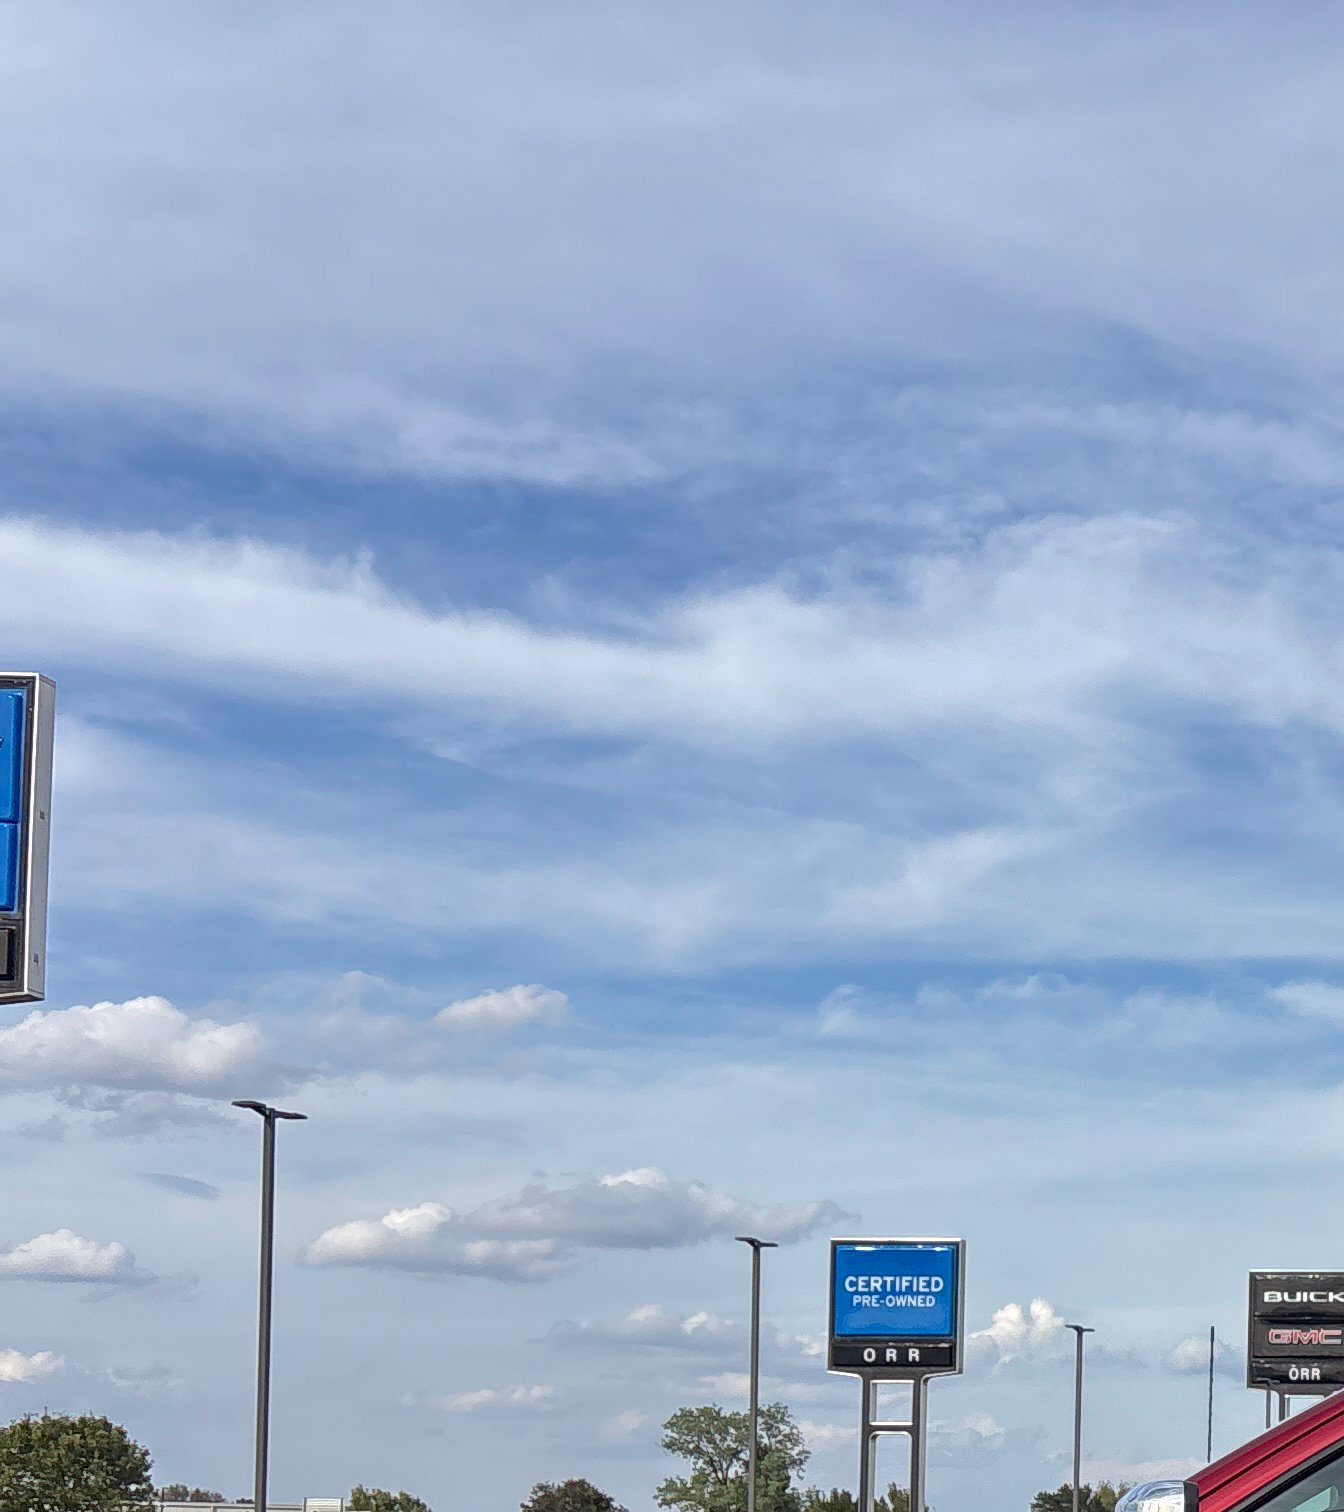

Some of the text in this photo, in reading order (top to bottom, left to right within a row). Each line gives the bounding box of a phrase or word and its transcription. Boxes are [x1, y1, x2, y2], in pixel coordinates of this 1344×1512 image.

[844, 1275, 945, 1293] CERTIFIED
[852, 1294, 936, 1308] PRE-OWNED
[1268, 1328, 1343, 1345] GMC
[863, 1347, 920, 1363] ORR
[1288, 1366, 1321, 1381] ORR
